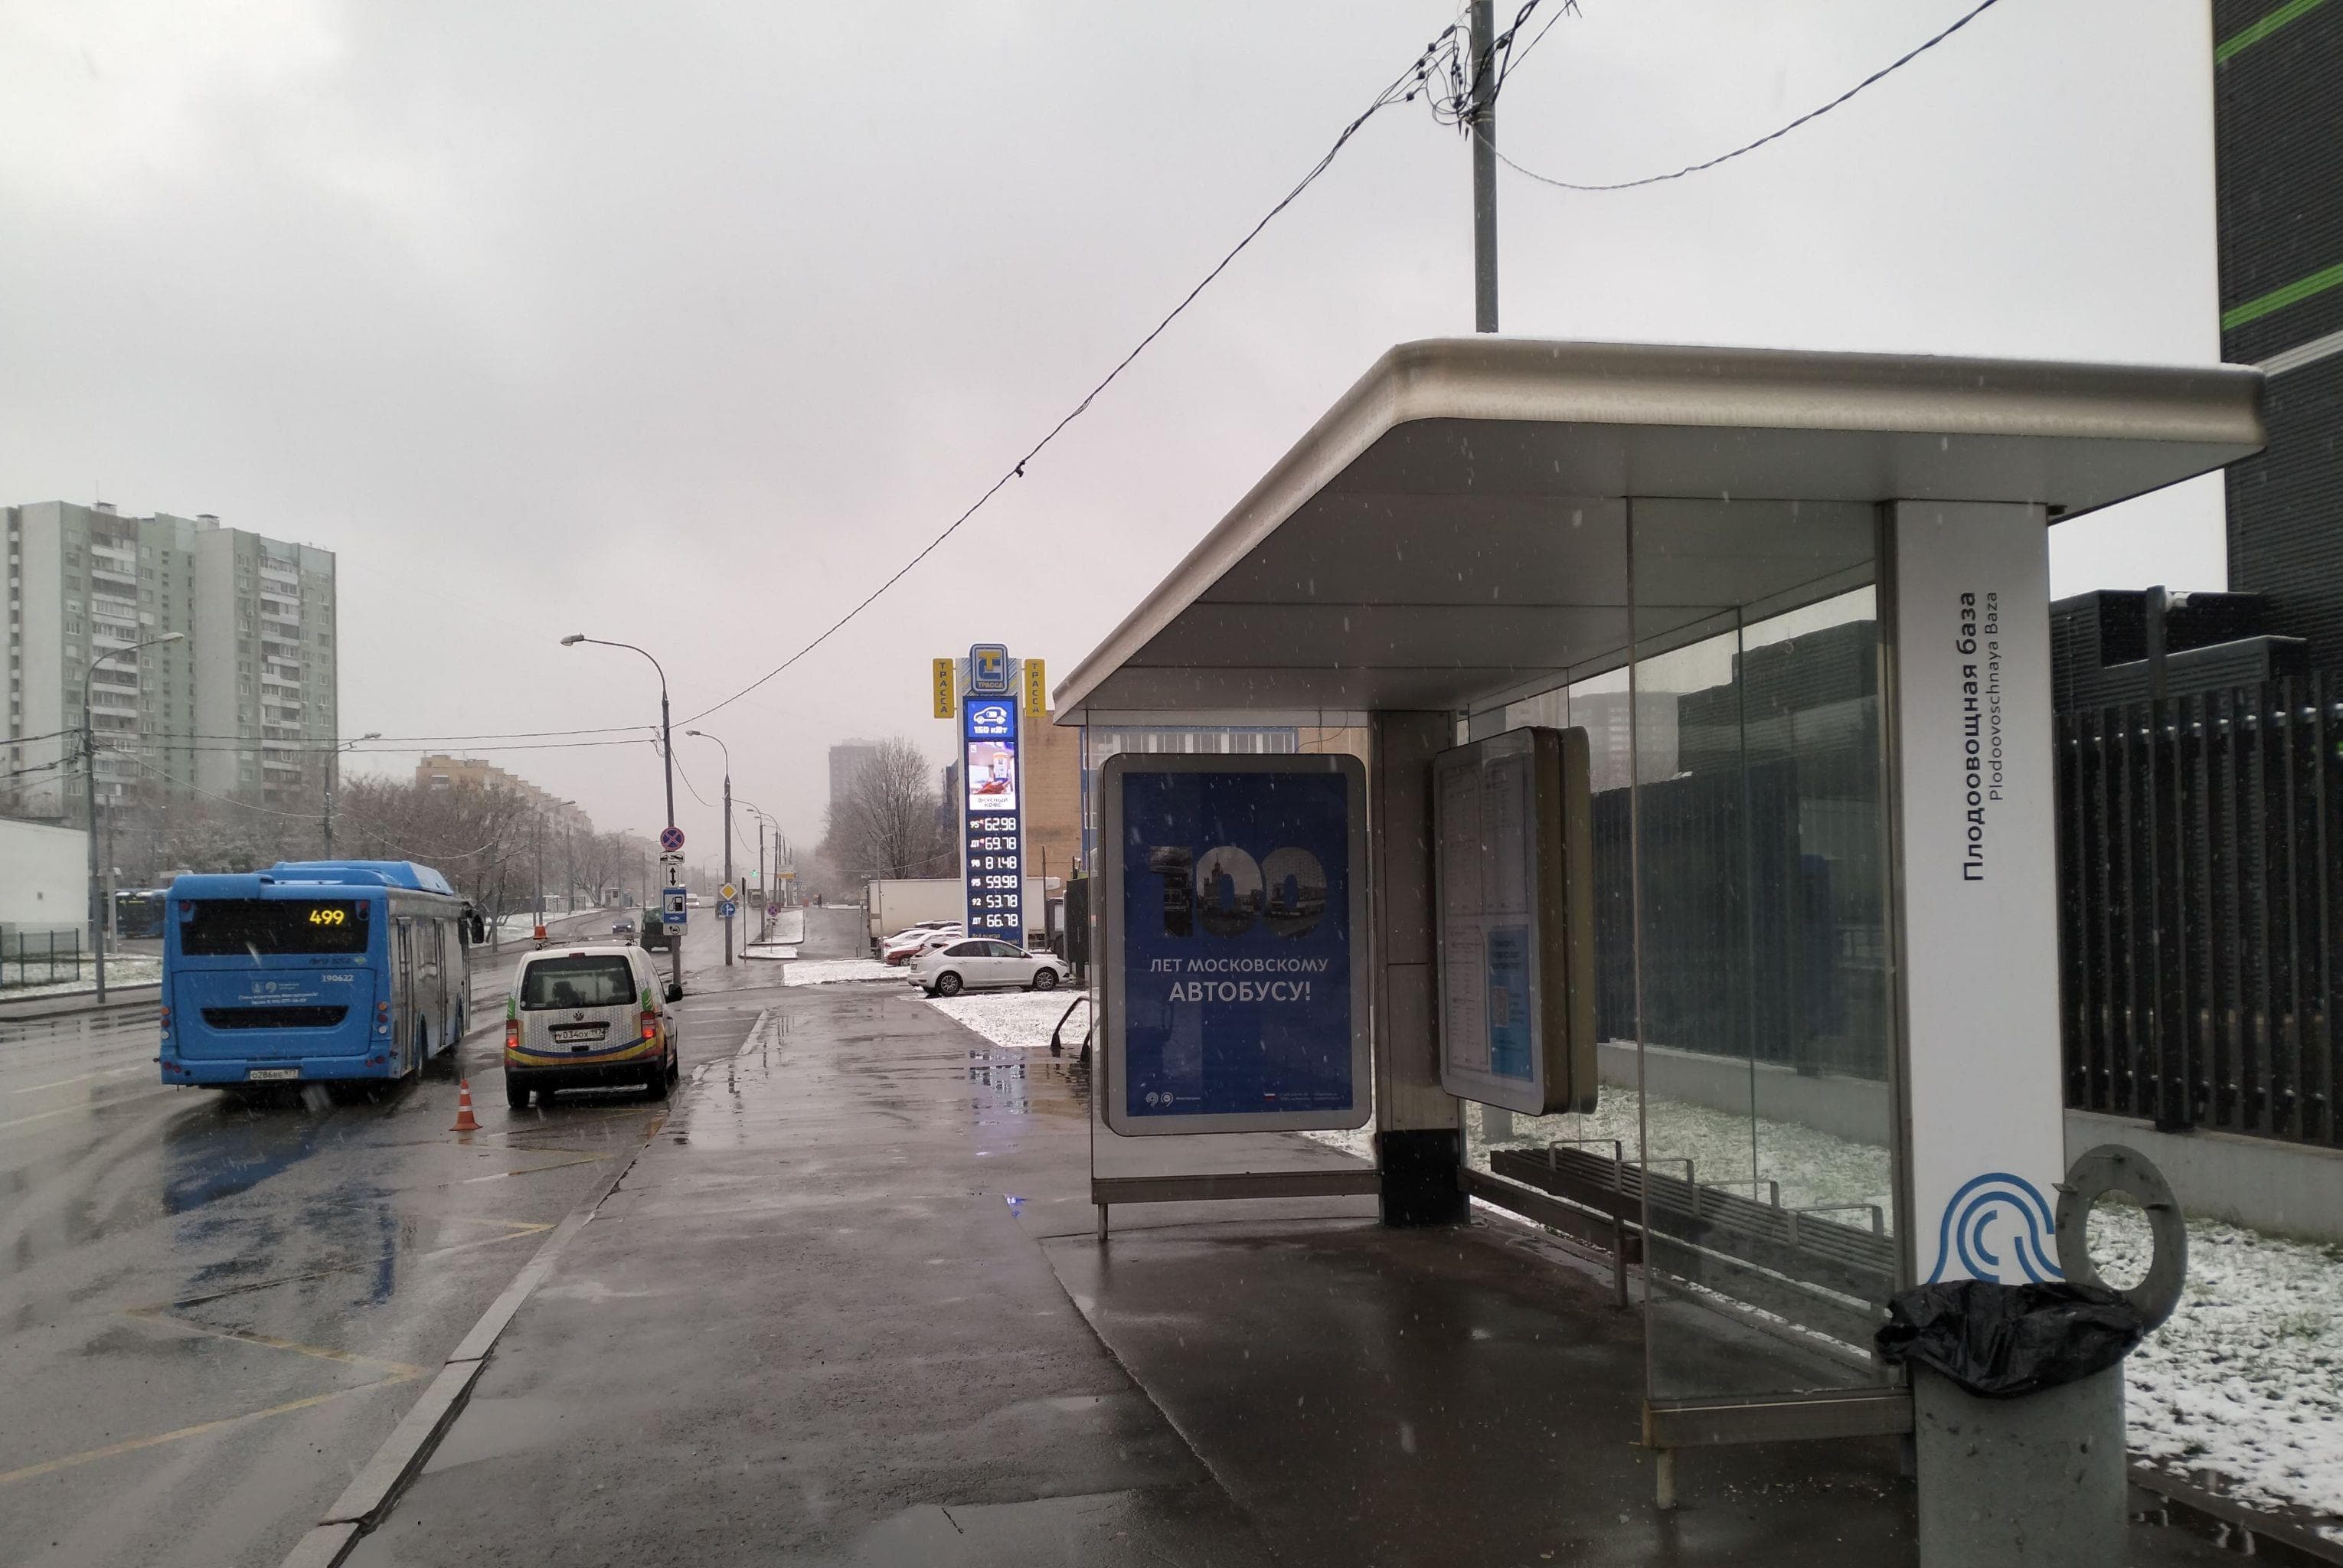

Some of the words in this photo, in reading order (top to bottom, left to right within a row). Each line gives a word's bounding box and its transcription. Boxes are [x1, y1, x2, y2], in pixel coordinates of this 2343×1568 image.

[1985, 593, 1998, 634] Baza
[1956, 592, 1976, 655] база
[939, 662, 948, 713] ТРАССА
[1031, 663, 1040, 713] ТРАССА
[1985, 641, 2004, 800] Plodoovoschnaya
[1963, 665, 1985, 881] Плодоовощная
[985, 818, 1016, 831] 62.98
[985, 837, 1017, 850] 69.78
[971, 859, 981, 867] 98
[986, 875, 1018, 888] 59.98
[986, 894, 1018, 907] 53.78
[1149, 845, 1328, 939] 100
[309, 910, 345, 925] 499
[987, 913, 1018, 927] 66.78
[1150, 959, 1183, 972] ЛЕТ
[1188, 959, 1328, 973] МОСКОВСКОМУ
[1168, 982, 1312, 1001] АВТОБУСУ!
